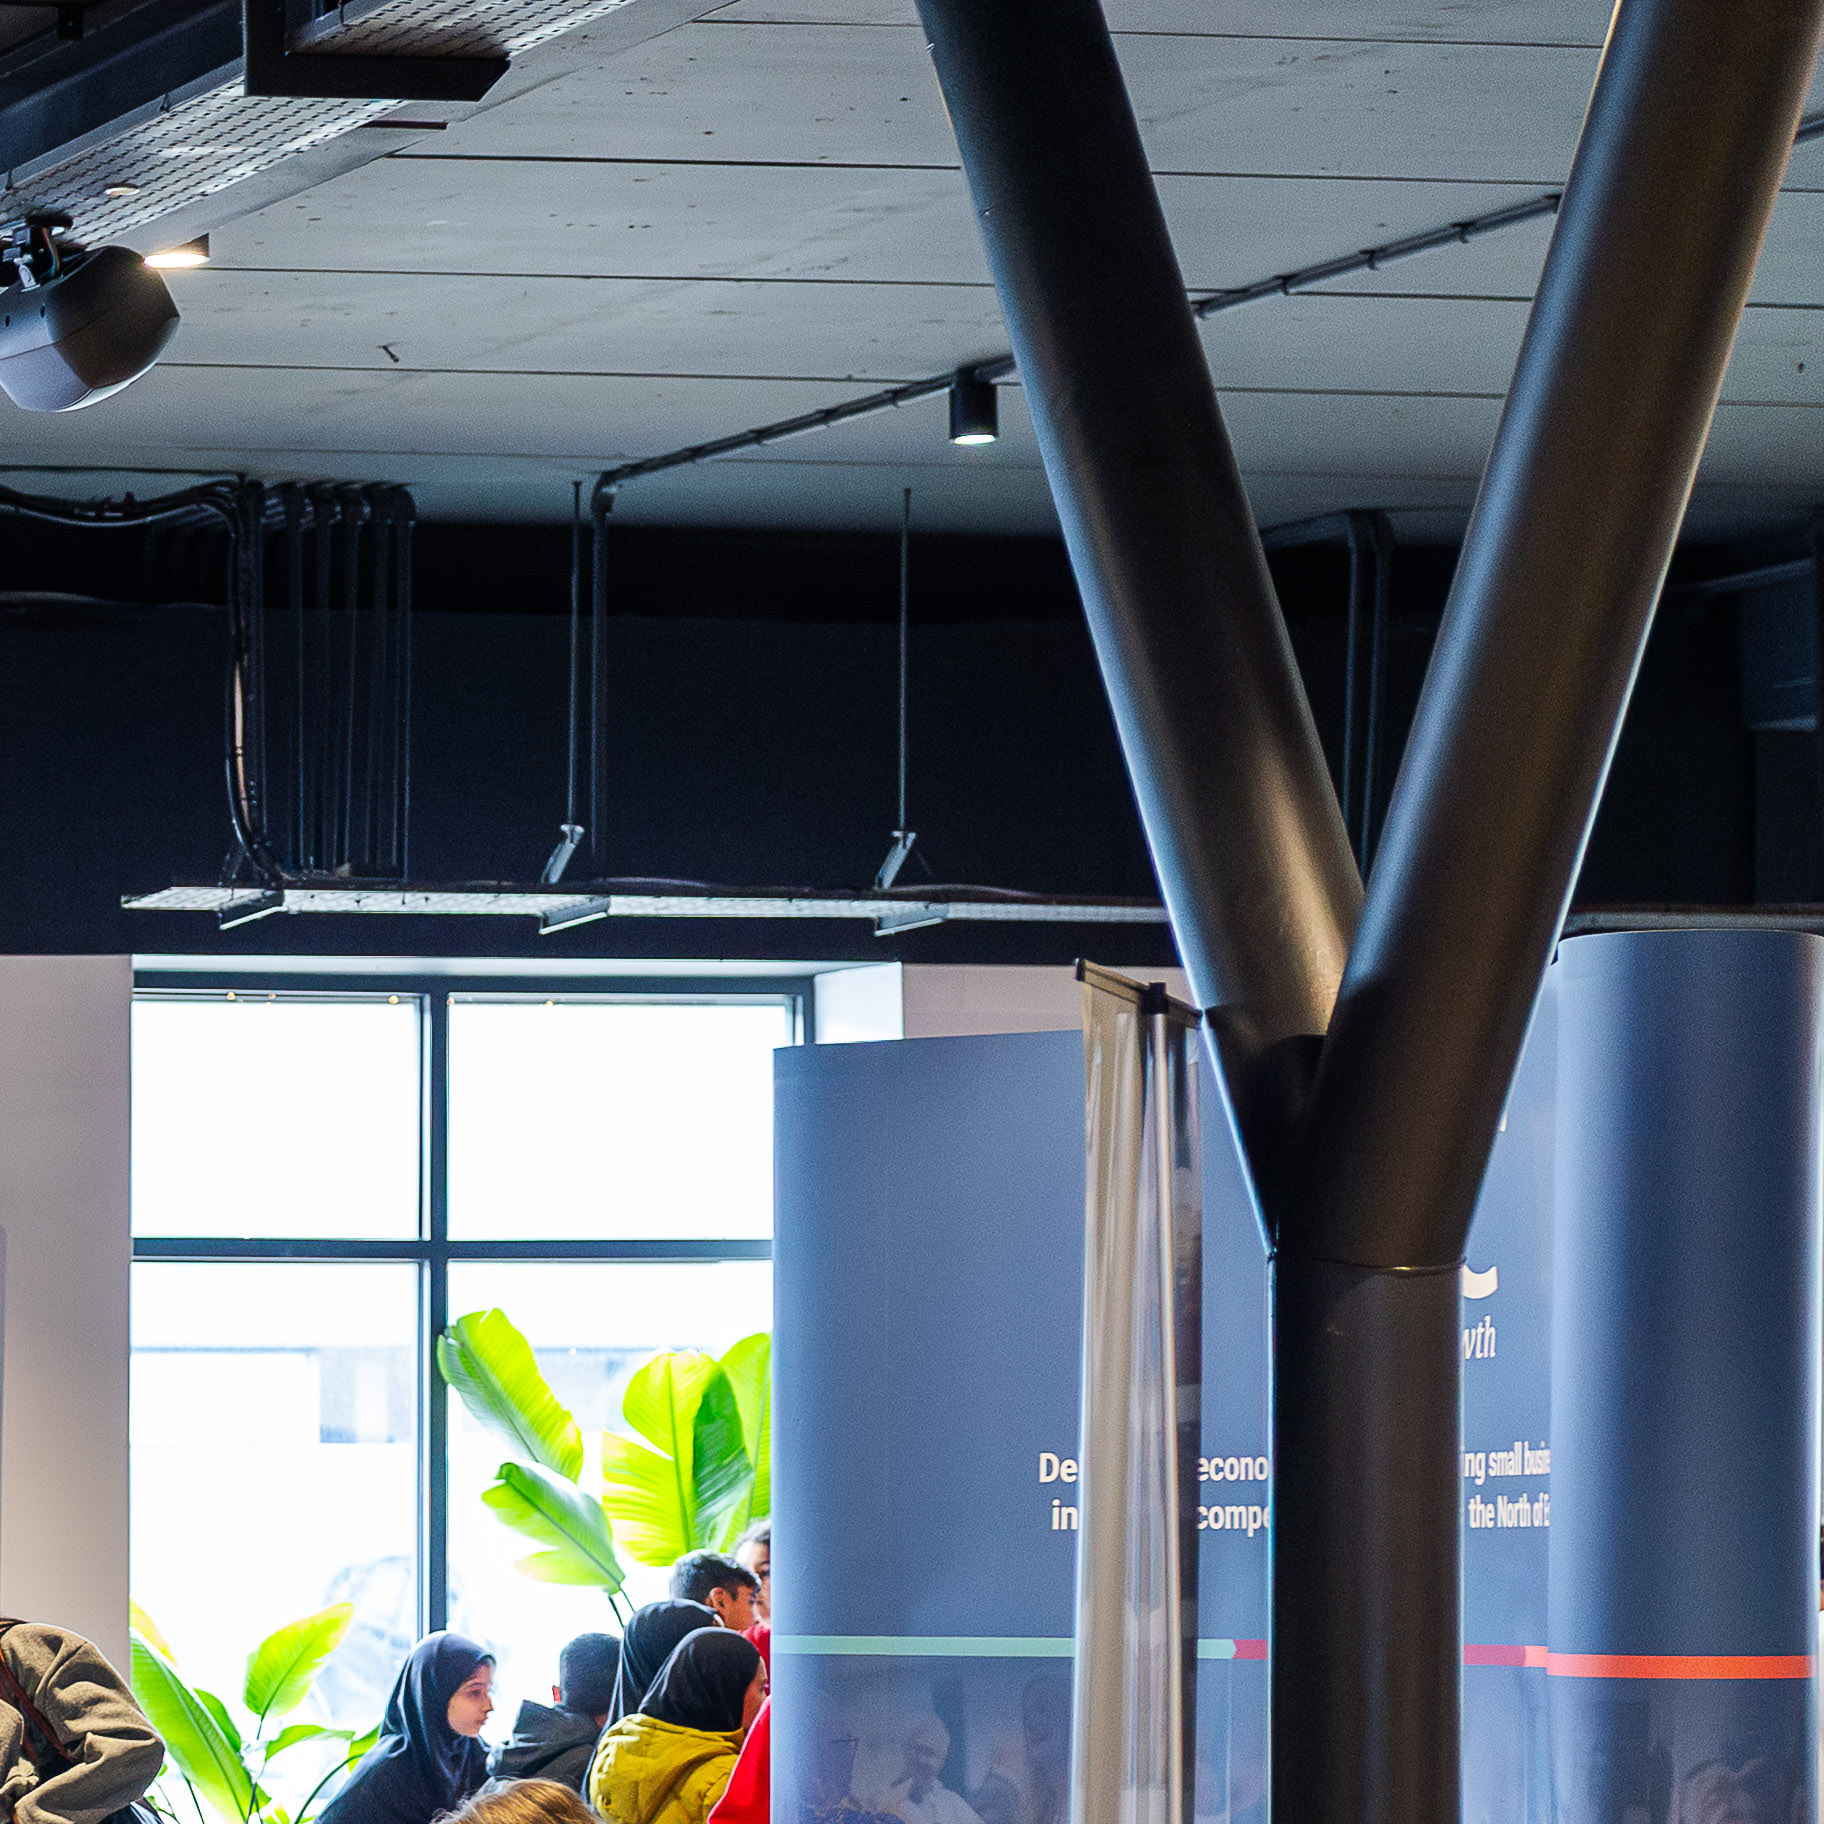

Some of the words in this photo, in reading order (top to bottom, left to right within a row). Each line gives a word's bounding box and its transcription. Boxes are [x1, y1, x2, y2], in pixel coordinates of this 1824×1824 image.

[1488, 1441, 1522, 1477] small
[1469, 1494, 1495, 1528] the
[1497, 1493, 1531, 1528] North
[1533, 1492, 1544, 1528] of
